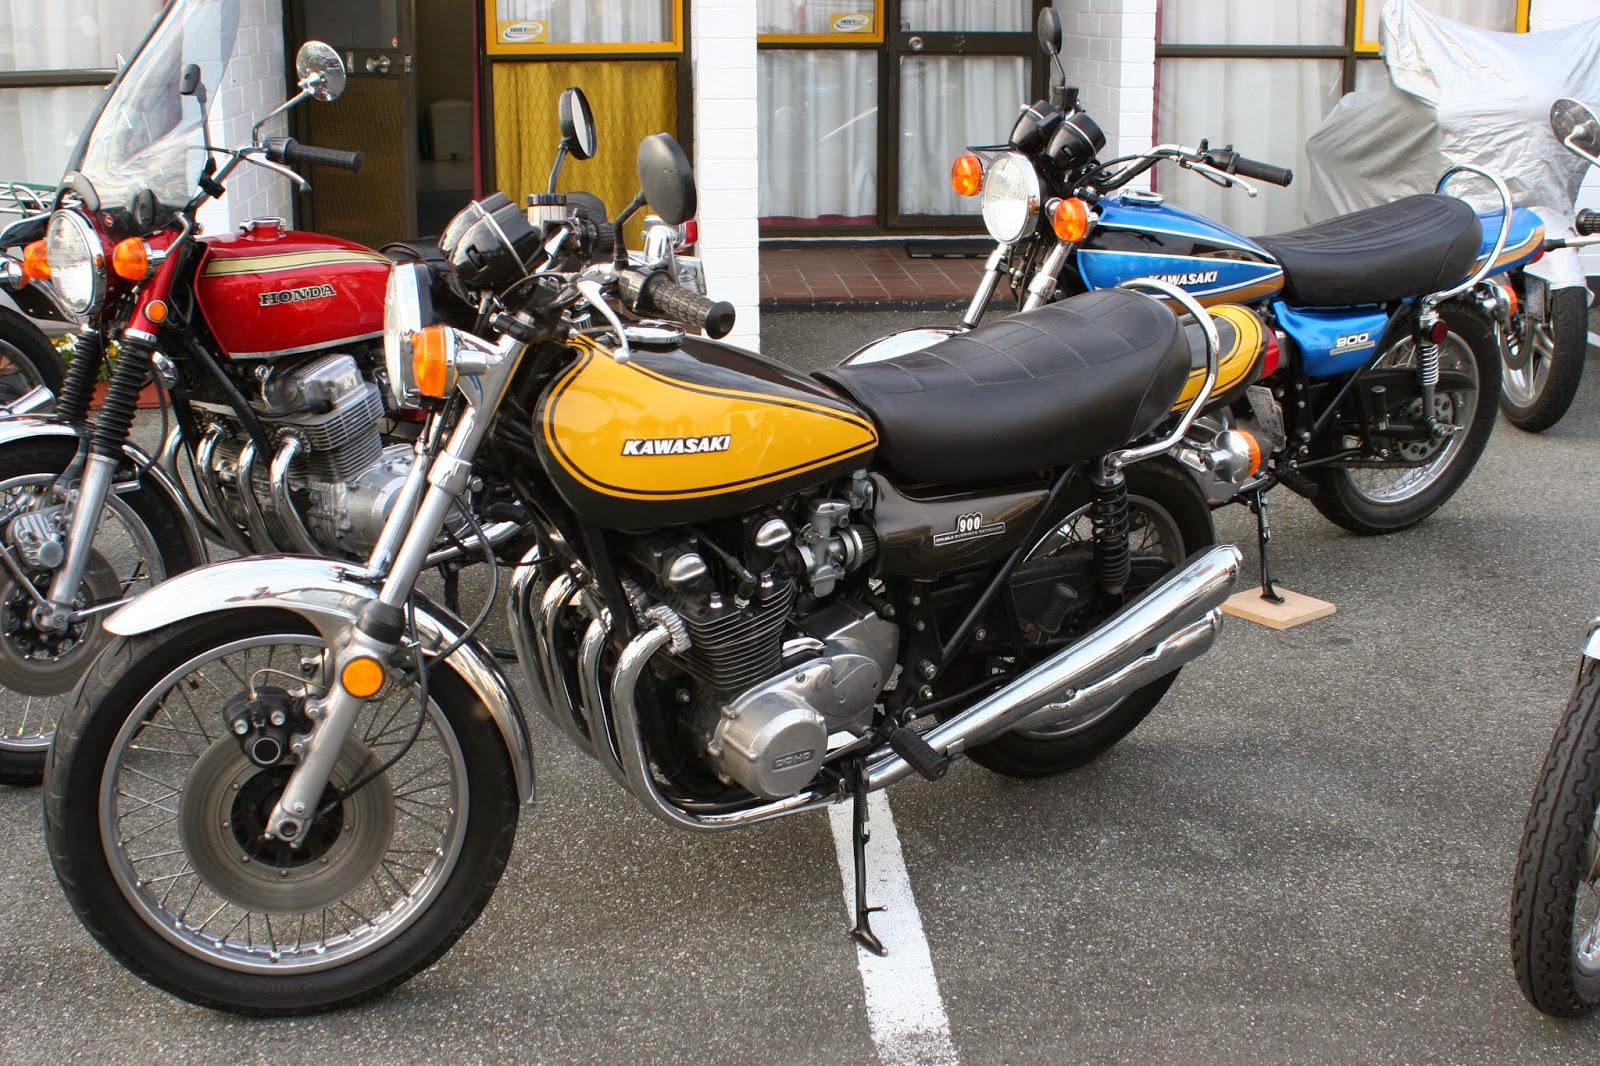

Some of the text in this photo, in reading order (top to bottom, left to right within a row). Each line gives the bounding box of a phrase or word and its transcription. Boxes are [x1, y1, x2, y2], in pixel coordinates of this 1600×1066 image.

[259, 284, 336, 306] HONDA
[1336, 333, 1369, 348] 900
[621, 434, 731, 456] KAWASAKI
[959, 516, 980, 533] 900
